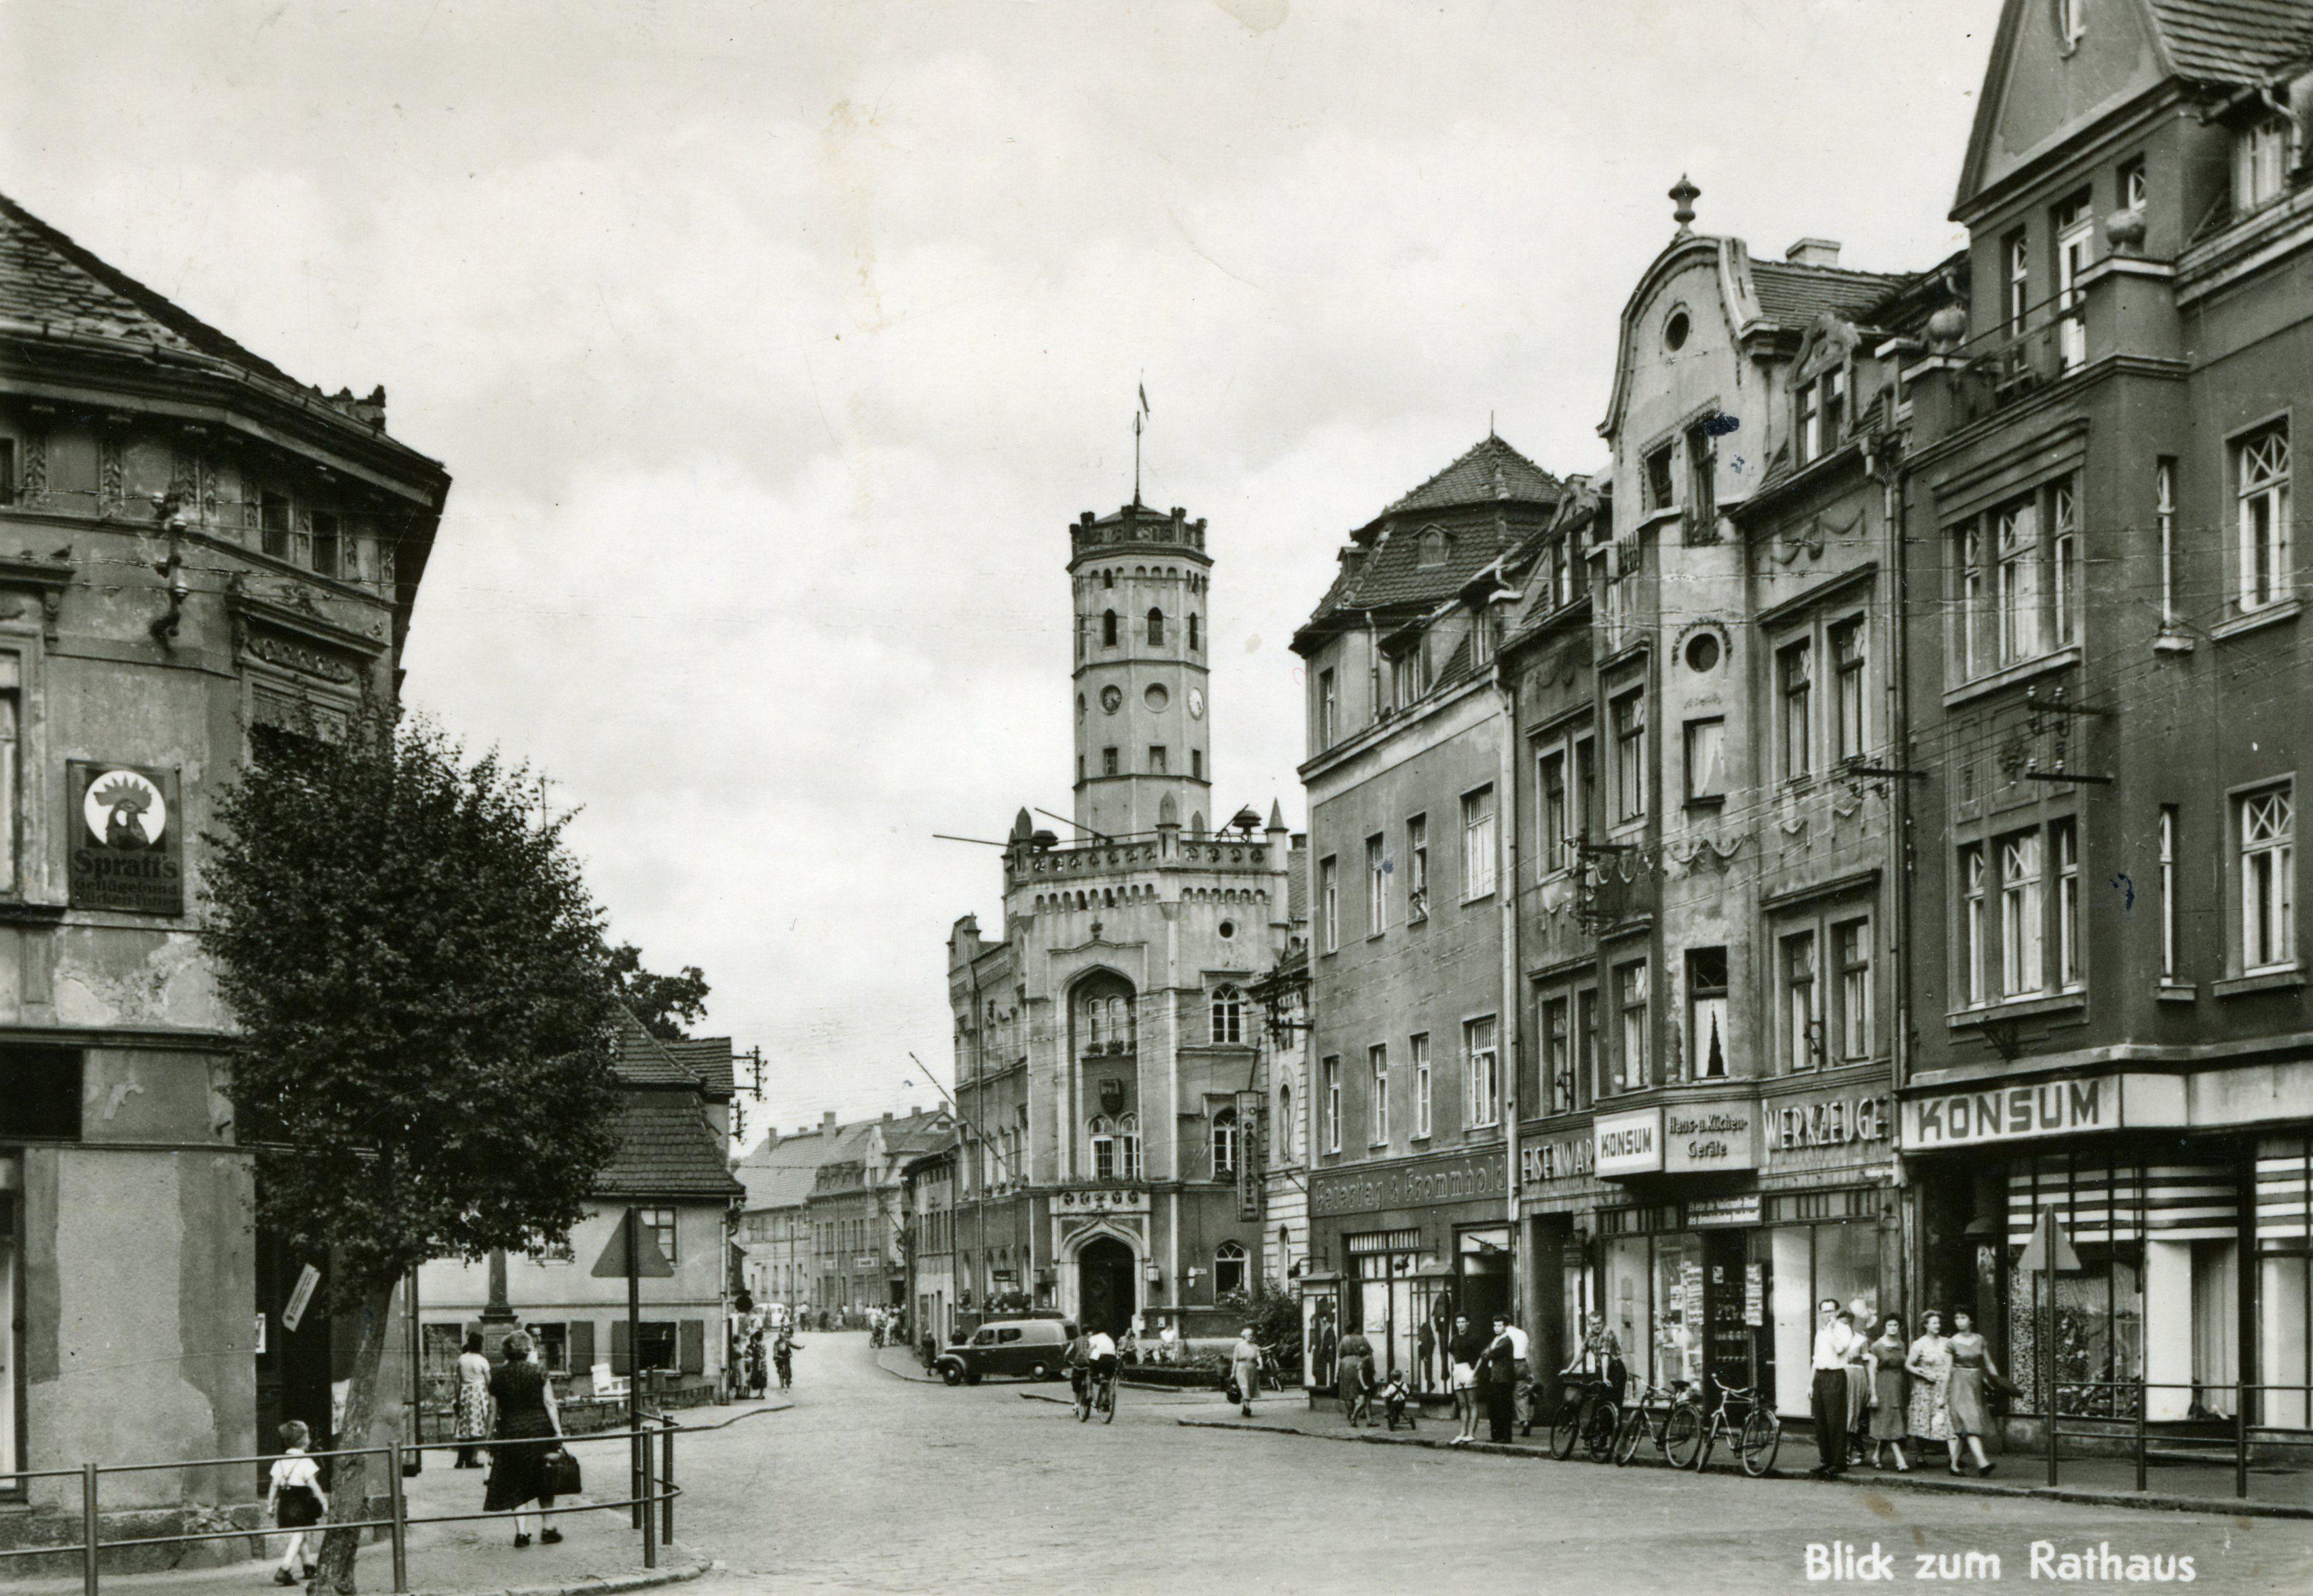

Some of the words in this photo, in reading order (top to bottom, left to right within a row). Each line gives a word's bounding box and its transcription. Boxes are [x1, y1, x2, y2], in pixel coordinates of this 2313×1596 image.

[74, 849, 178, 880] Spratt's
[1763, 1095, 1889, 1150] WERKZEUGE
[1918, 1080, 2099, 1143] KONSUM
[1600, 1126, 1652, 1159] KONSUM
[1688, 1141, 1727, 1158] Geräte
[1316, 1175, 1383, 1212] Feiertag
[1391, 1175, 1399, 1203] &
[1405, 1154, 1507, 1202] Frommhold
